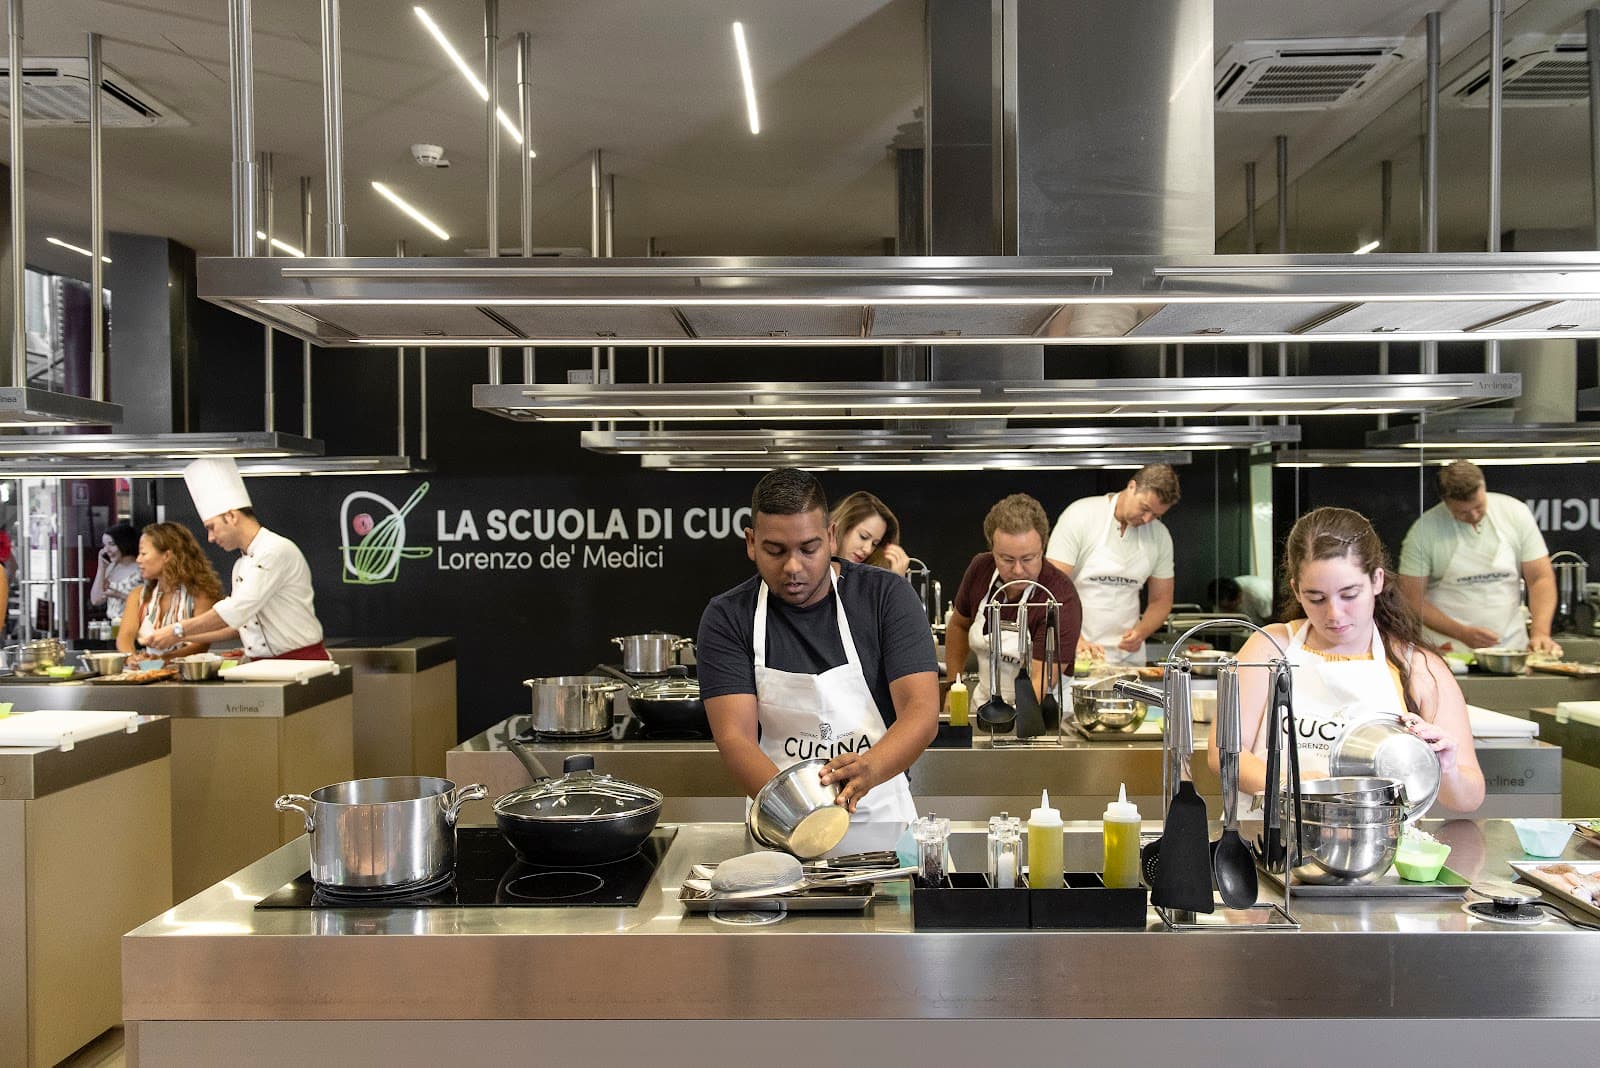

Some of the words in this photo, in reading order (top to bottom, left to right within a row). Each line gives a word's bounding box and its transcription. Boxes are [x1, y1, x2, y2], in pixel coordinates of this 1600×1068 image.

[437, 509, 480, 541] LA
[486, 508, 630, 541] SCUOLA
[637, 508, 673, 540] DI
[438, 546, 533, 570] Lorenzo
[540, 544, 575, 569] de'
[583, 544, 664, 568] Medici
